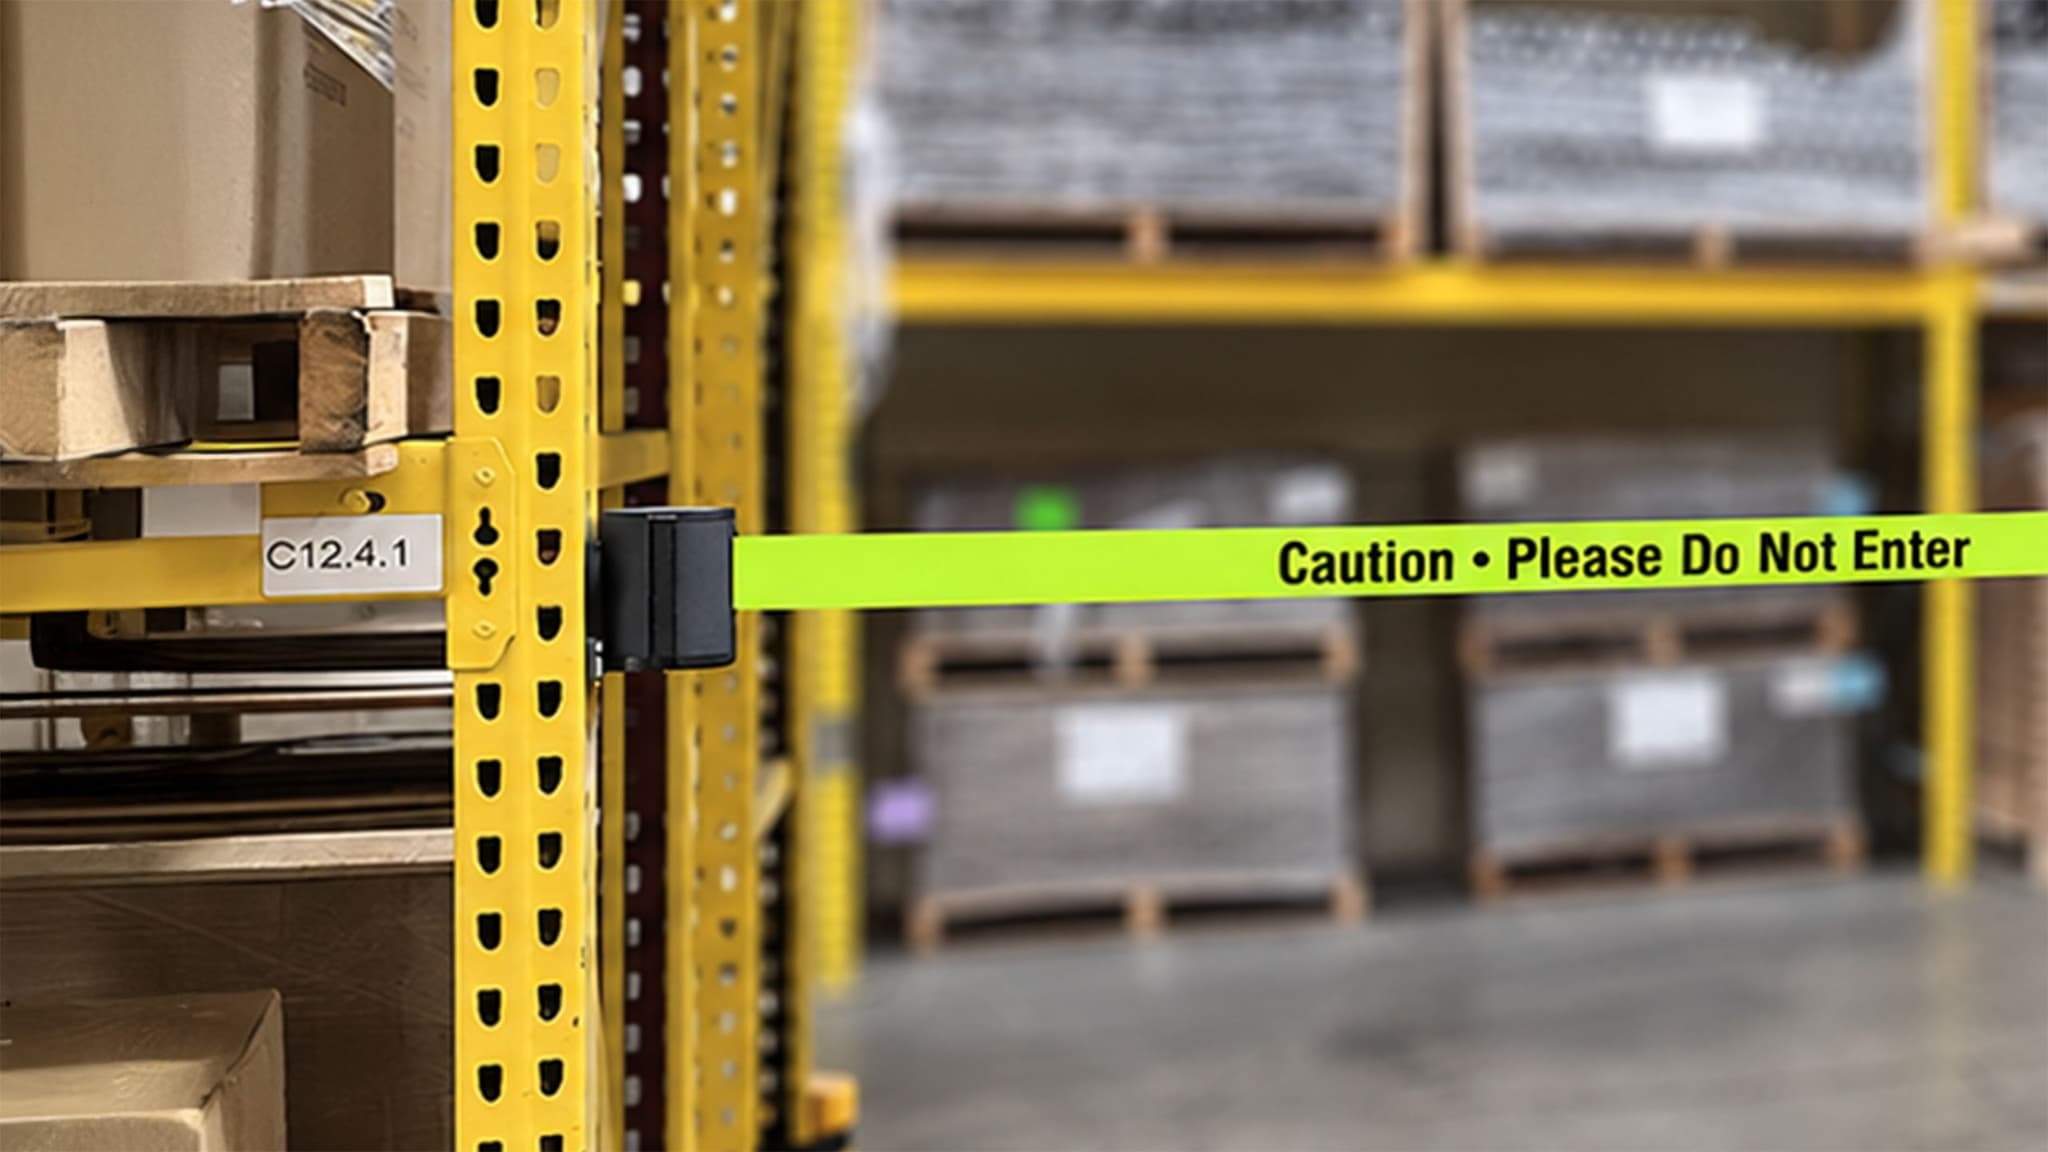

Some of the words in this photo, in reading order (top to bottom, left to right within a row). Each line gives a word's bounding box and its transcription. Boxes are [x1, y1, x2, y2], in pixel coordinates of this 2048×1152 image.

[266, 539, 406, 570] C12.4.1
[1279, 540, 1454, 585] Caution
[1507, 536, 1662, 580] Please
[1681, 533, 1740, 576] Do
[1758, 531, 1837, 574] Not
[1853, 528, 1972, 571] Enter
